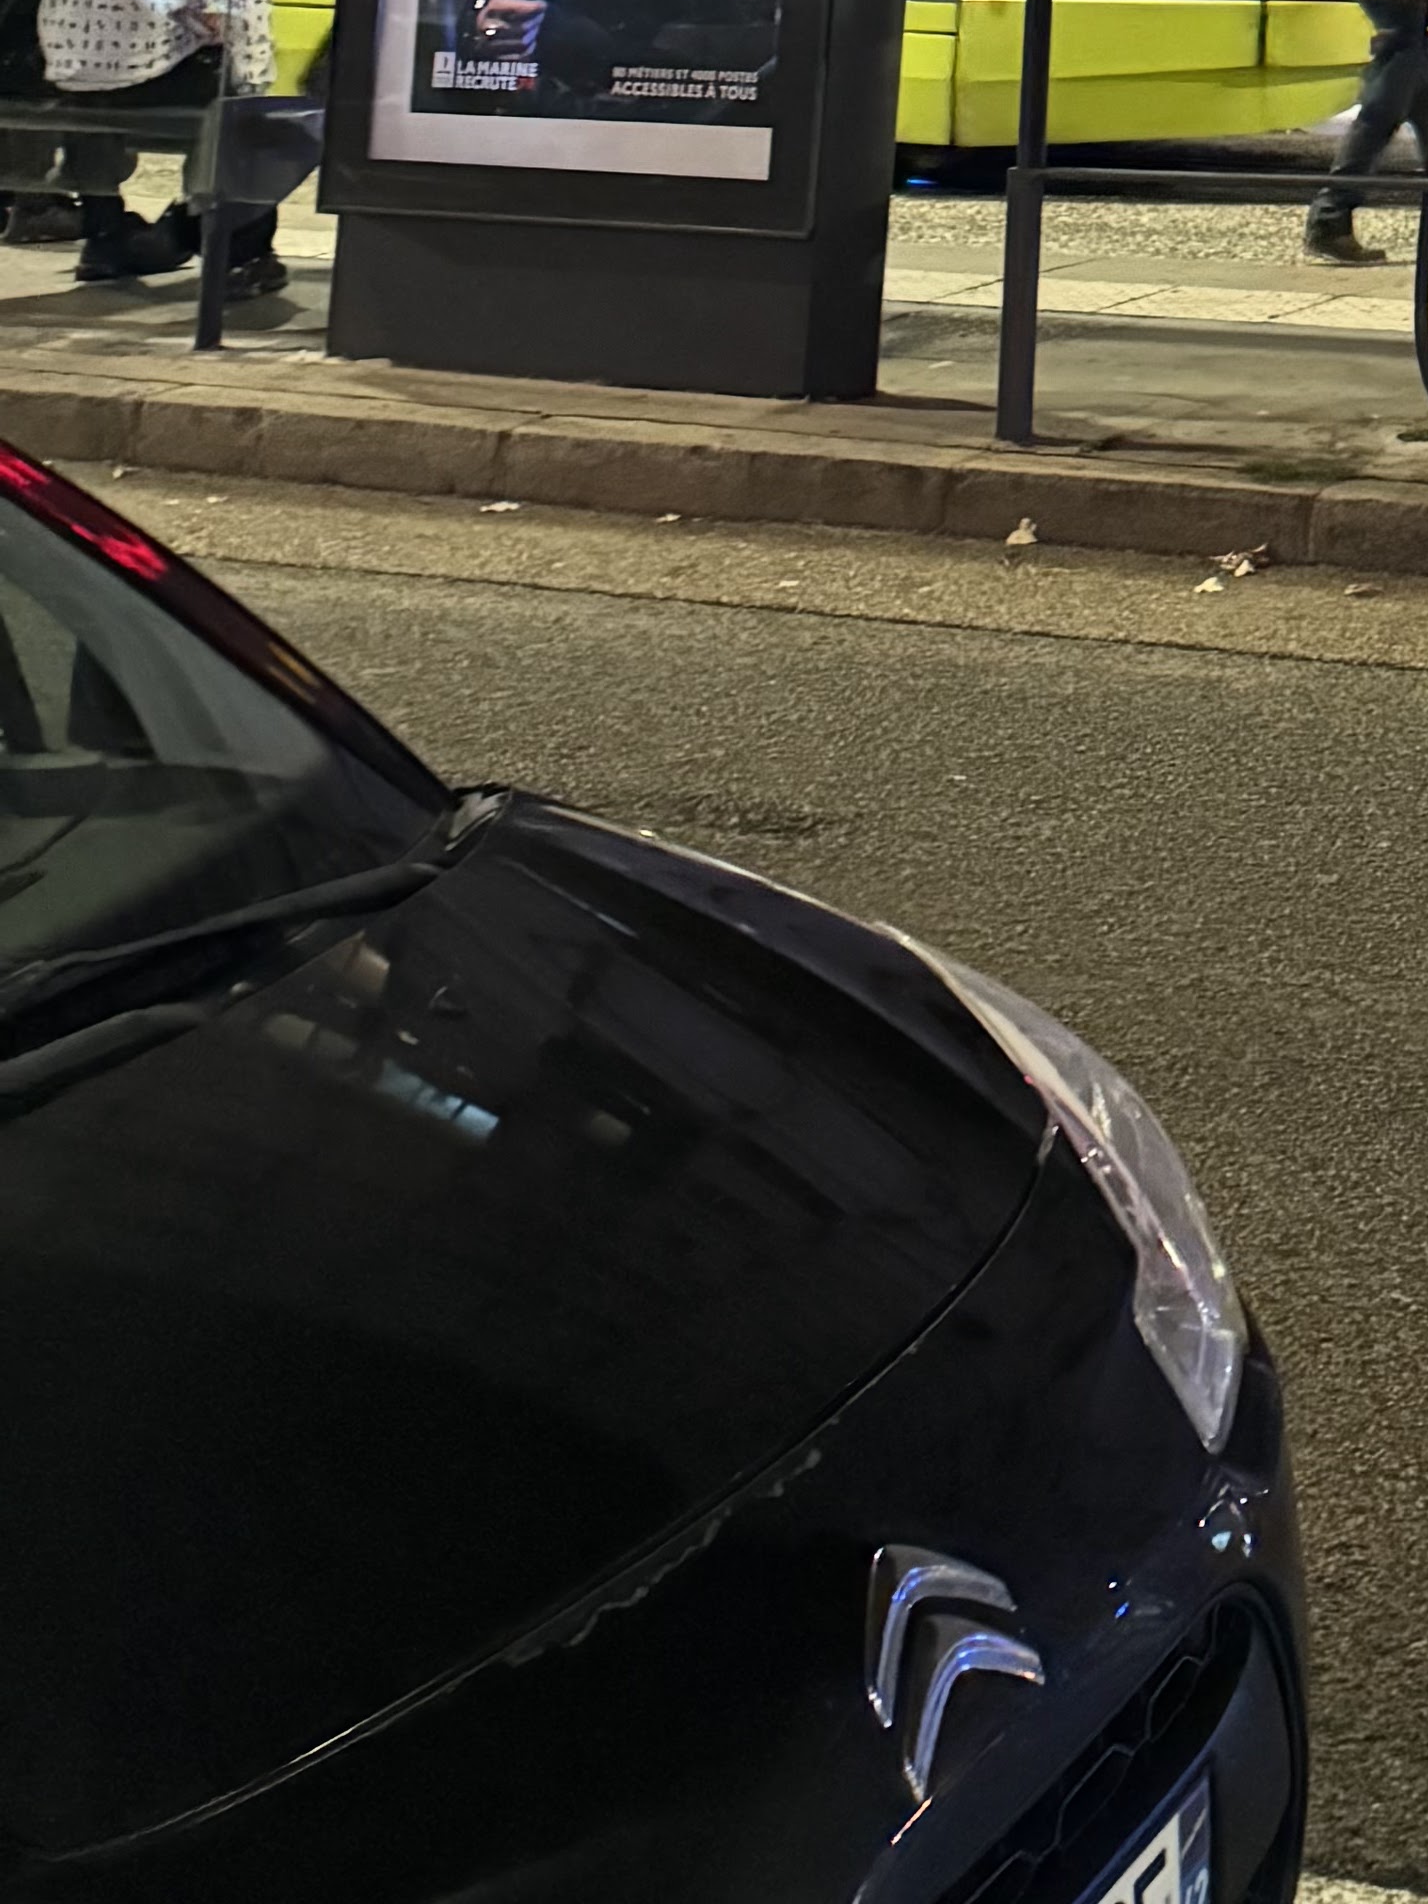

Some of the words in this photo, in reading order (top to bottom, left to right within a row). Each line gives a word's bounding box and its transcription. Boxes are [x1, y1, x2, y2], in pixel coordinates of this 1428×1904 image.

[610, 80, 703, 98] ACCESSIBLES
[704, 82, 716, 99] À
[719, 85, 758, 101] TOUS
